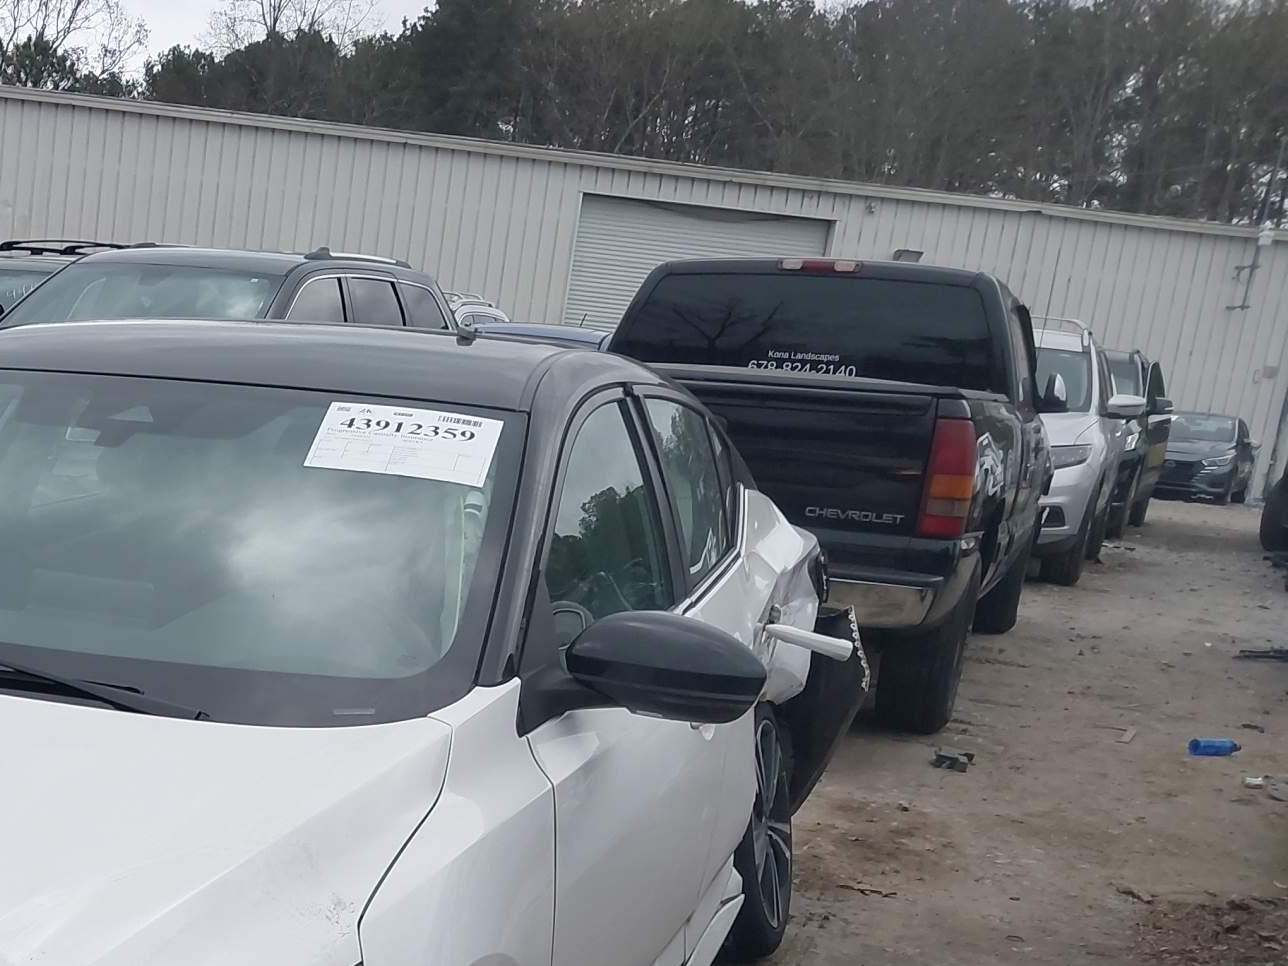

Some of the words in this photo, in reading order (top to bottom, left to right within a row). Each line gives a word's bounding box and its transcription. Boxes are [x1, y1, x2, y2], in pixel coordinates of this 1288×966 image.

[767, 349, 789, 359] Kona
[790, 351, 840, 362] Landscapes
[339, 417, 476, 442] 43912359
[804, 506, 905, 525] CHEVROLET
